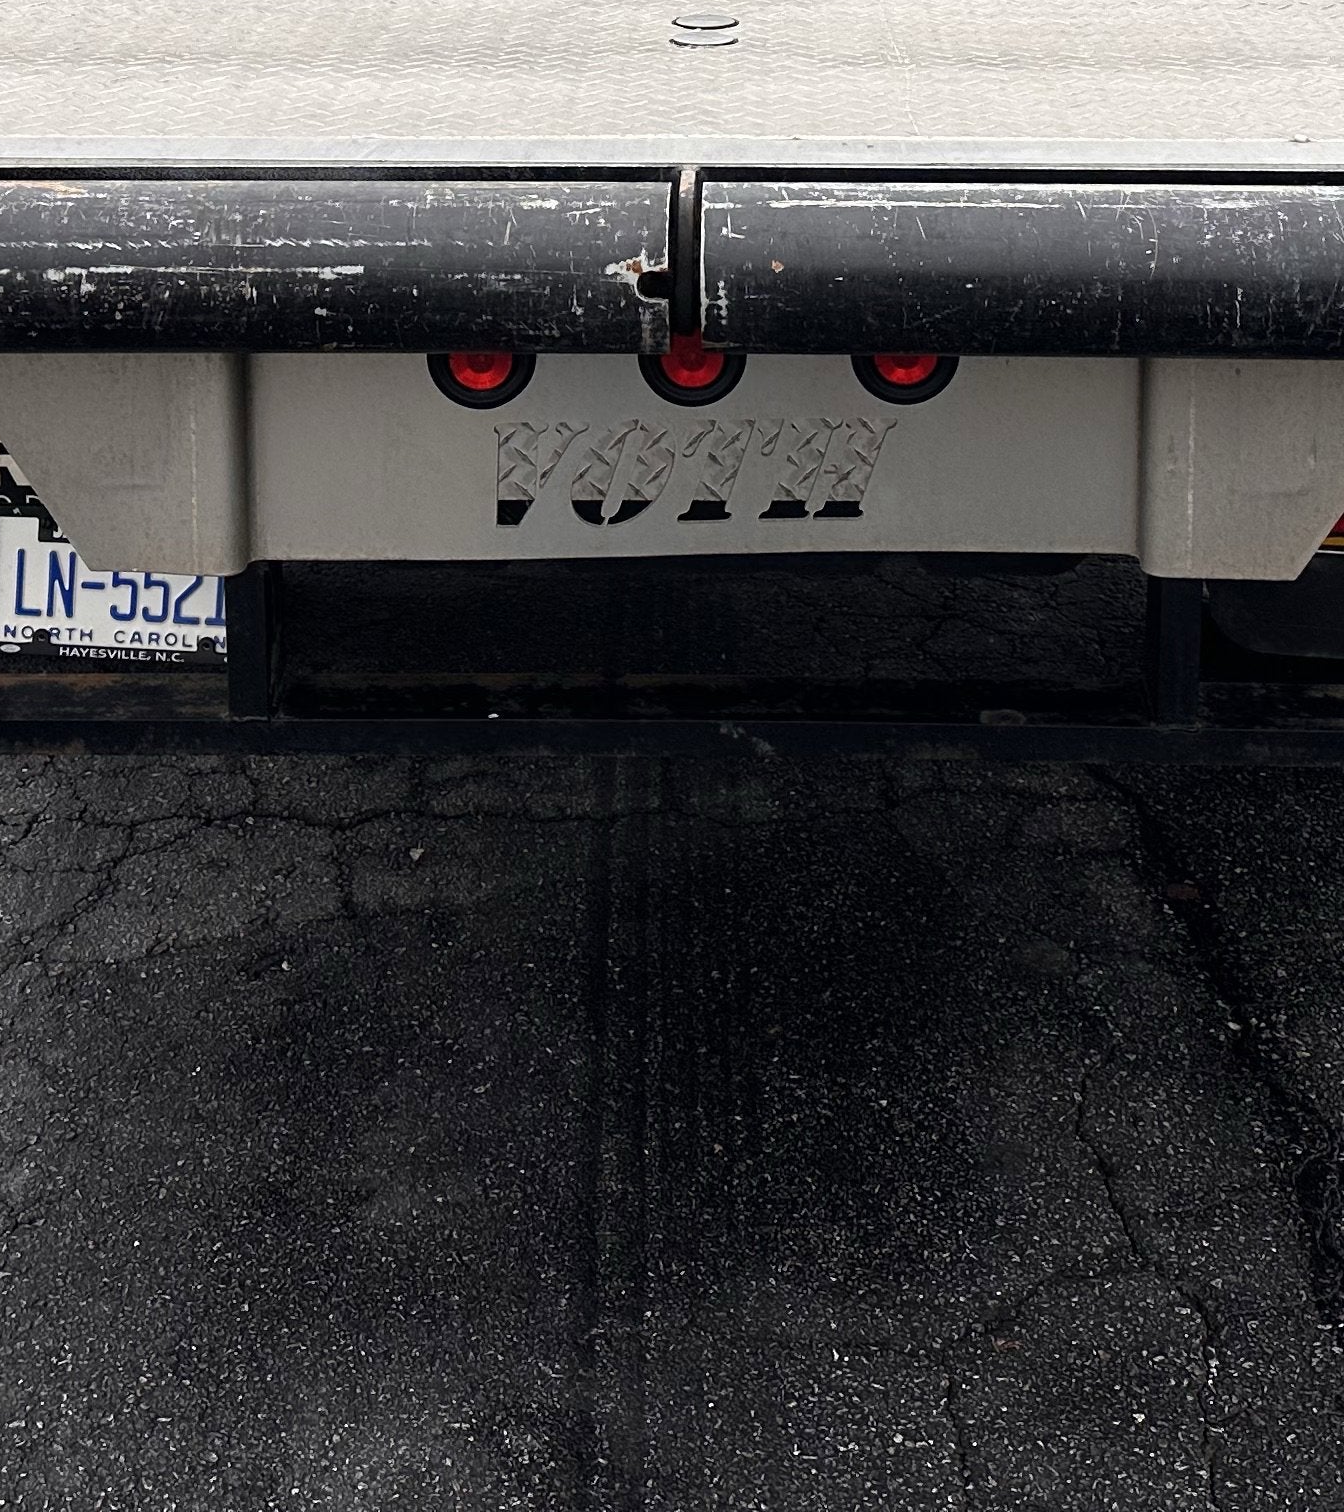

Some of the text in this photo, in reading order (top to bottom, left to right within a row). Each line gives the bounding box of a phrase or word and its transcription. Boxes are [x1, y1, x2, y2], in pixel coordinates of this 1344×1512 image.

[494, 417, 898, 528] VOTH
[3, 624, 94, 642] NORTH
[155, 651, 185, 663] N.C.
